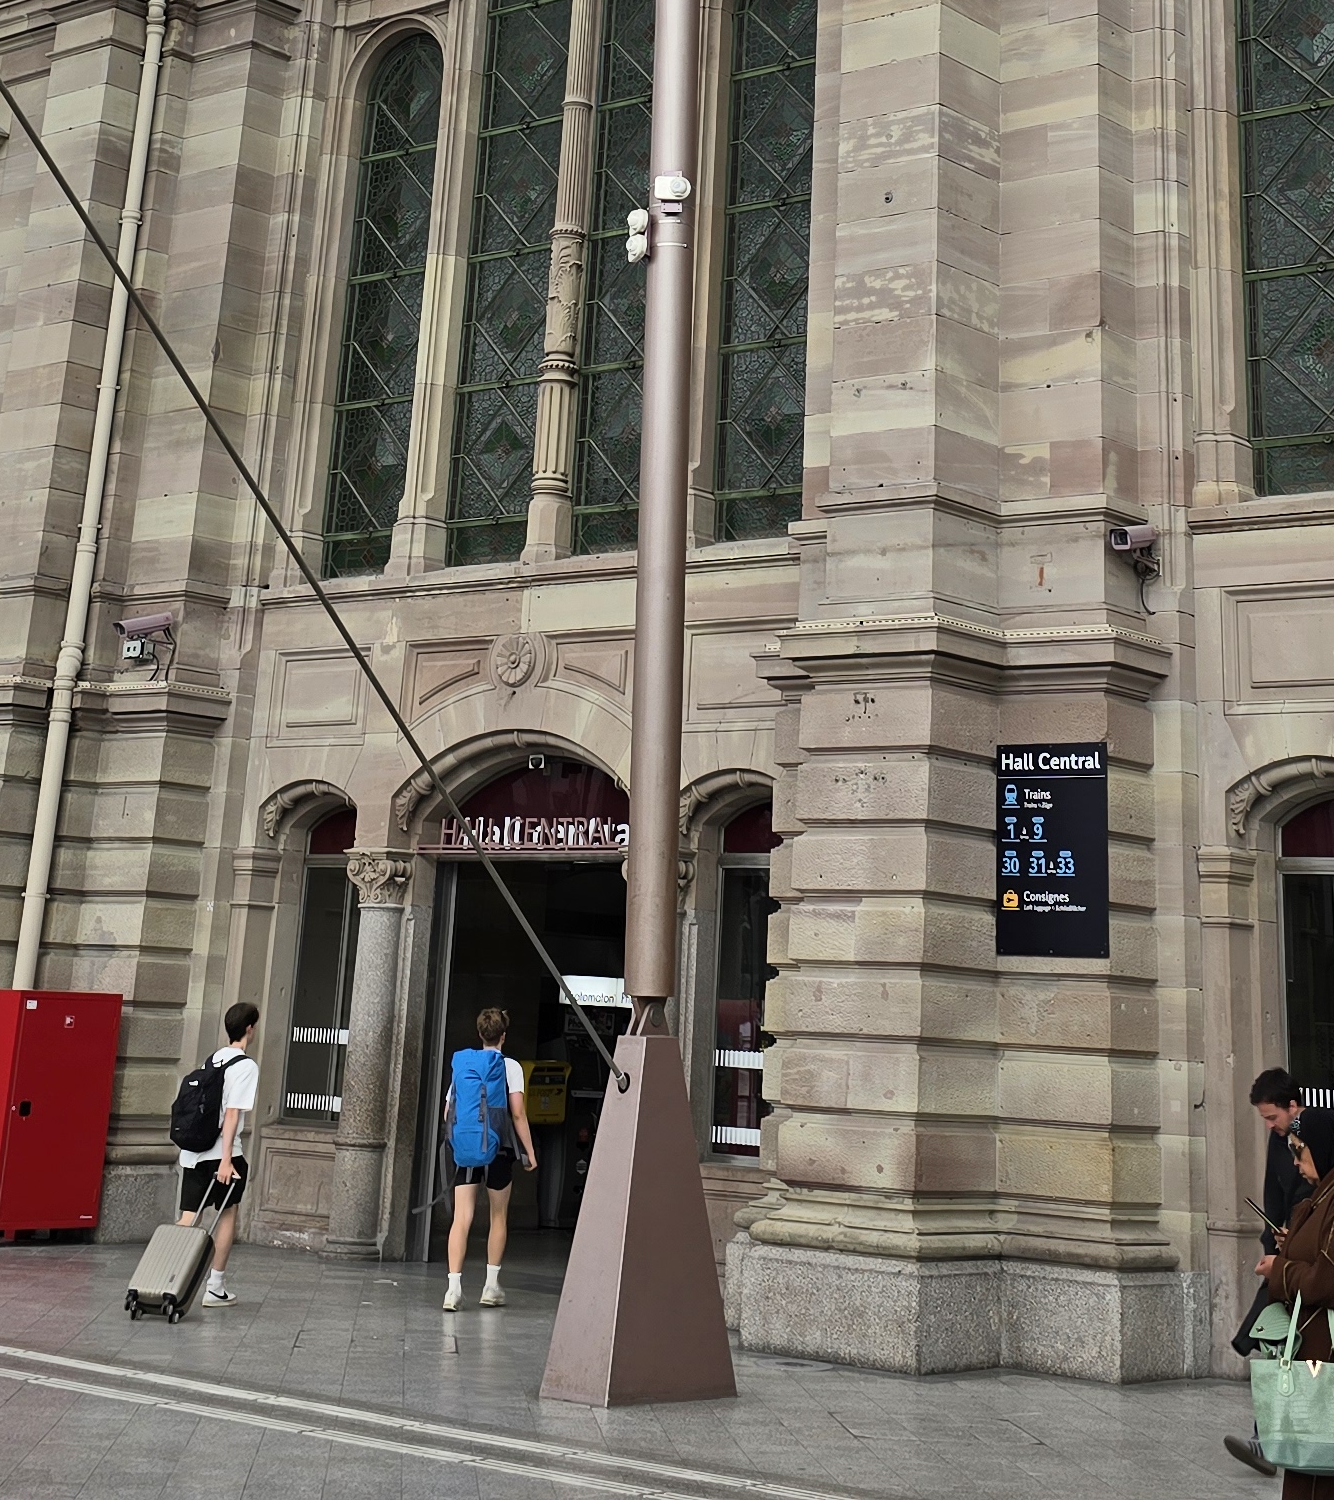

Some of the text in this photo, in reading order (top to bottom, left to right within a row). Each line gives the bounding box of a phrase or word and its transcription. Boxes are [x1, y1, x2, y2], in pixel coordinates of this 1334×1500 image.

[1001, 751, 1100, 771] Hall Central
[1024, 789, 1051, 800] Trains
[1007, 824, 1014, 839] 1
[1034, 824, 1043, 839] 9
[1002, 858, 1019, 873] 30
[1029, 858, 1046, 873] 31
[1057, 858, 1074, 873] 33
[1024, 891, 1069, 905] Consignes
